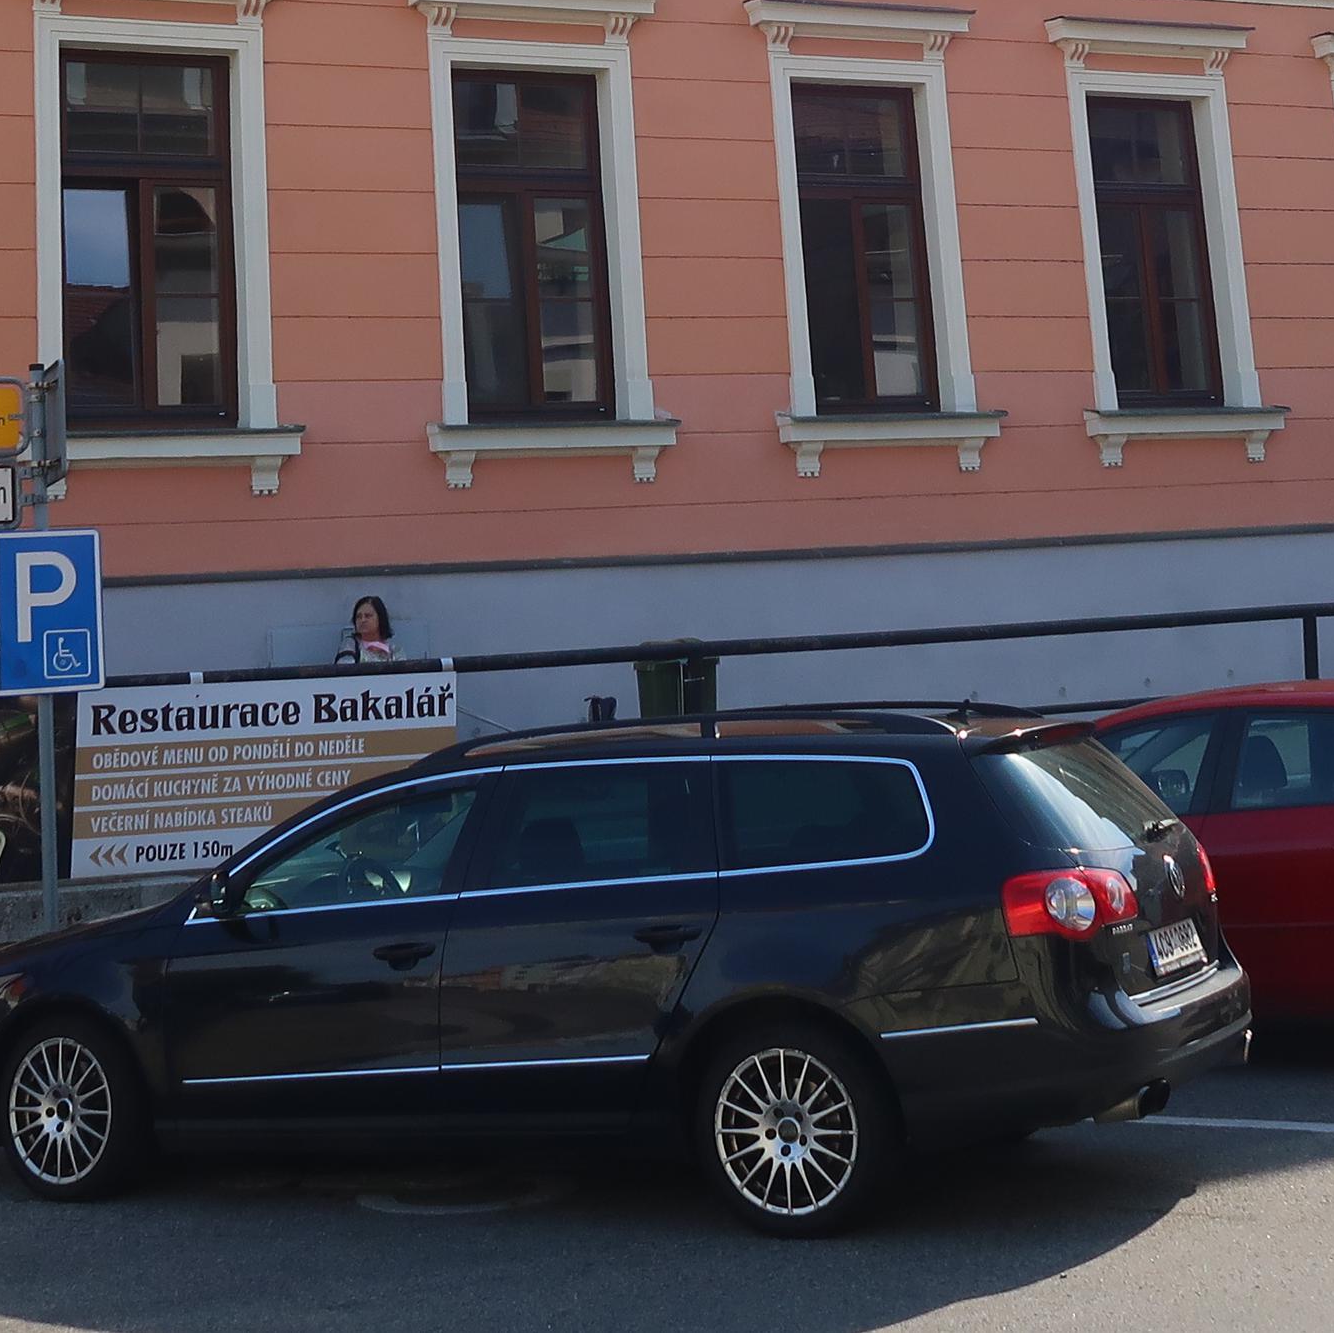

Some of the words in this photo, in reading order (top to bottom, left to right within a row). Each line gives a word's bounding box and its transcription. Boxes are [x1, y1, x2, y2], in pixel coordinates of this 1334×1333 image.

[15, 551, 78, 643] P
[91, 698, 301, 736] Restaurace
[312, 682, 454, 724] Bakalář
[92, 745, 159, 769] OBĚDOVÉ
[163, 746, 204, 766] MENU
[208, 744, 227, 762] OD
[233, 738, 291, 761] PONDĚLÍ
[295, 741, 314, 758] DO
[318, 735, 365, 755] NEDĚLE
[91, 778, 149, 802] DOMÁCÍ
[154, 773, 218, 797] KUCHYNĚ
[223, 776, 242, 794] ZA
[246, 768, 313, 791] VÝHODNÉ
[316, 770, 351, 787] CENY
[91, 810, 150, 833] VEČERNÍ
[154, 807, 217, 830] NABÍDKA
[135, 842, 186, 863] POUZE
[192, 840, 234, 860] 150m
